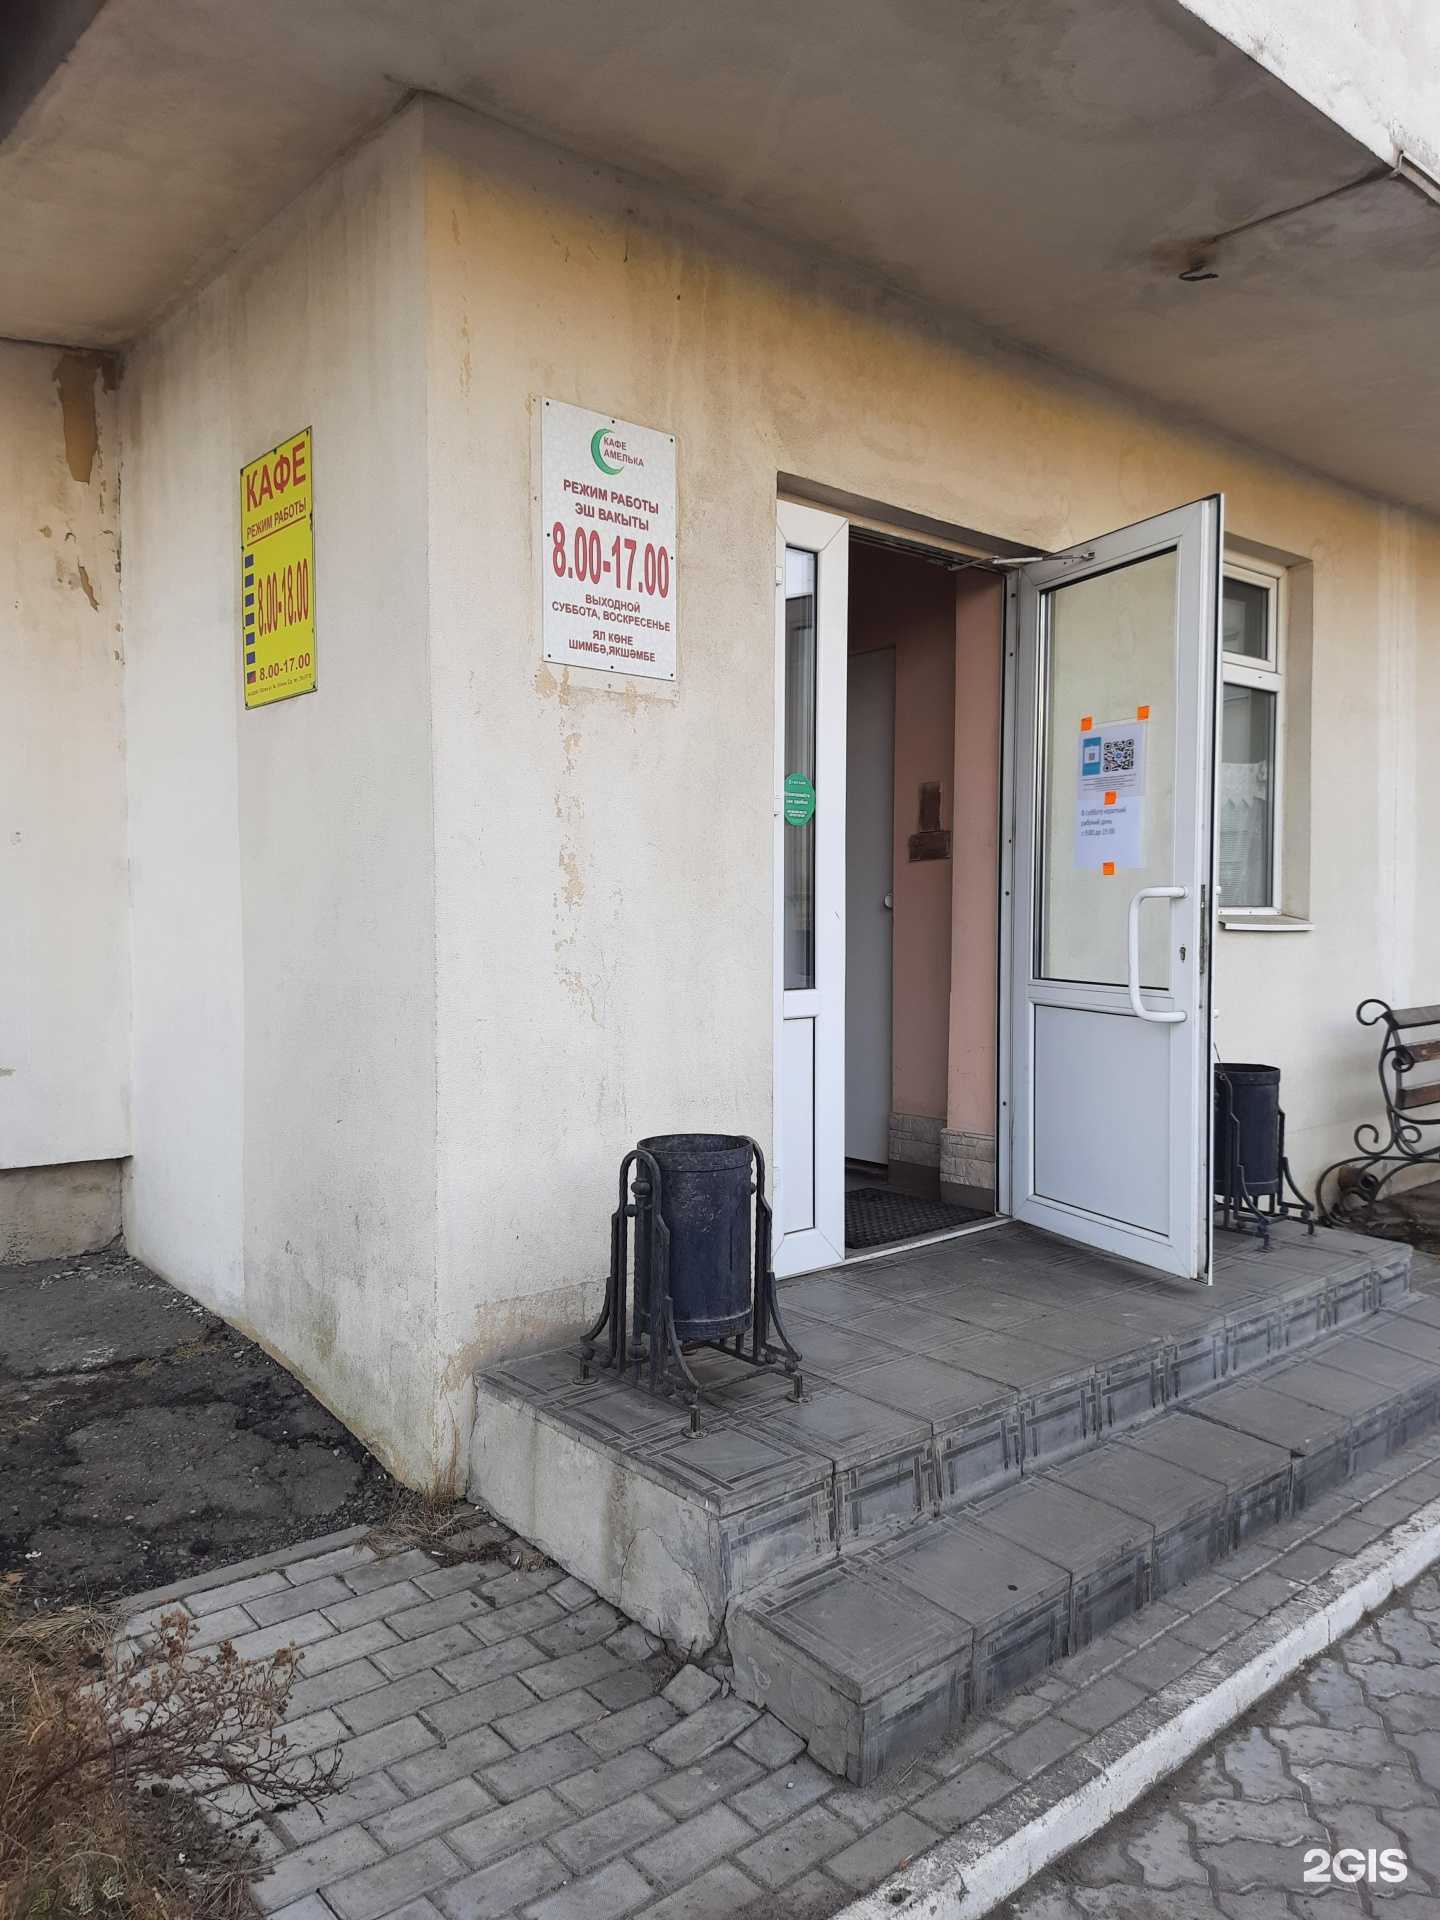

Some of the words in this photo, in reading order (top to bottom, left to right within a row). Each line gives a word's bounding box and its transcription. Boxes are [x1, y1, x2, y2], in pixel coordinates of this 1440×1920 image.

[604, 437, 627, 450] КАФЕ
[604, 449, 644, 467] АМЕЛЬКА
[246, 441, 306, 512] КАФЕ
[563, 479, 608, 501] РЕЖИМ
[610, 491, 659, 514] РАБОТЫ
[247, 515, 273, 540] РЕЖИМ
[274, 497, 306, 526] РАБОТЫ
[575, 502, 595, 518] ЭШ
[598, 508, 649, 531] ВАКЫТЫ
[552, 521, 669, 598] 8.00-17.00
[258, 558, 309, 636] 8.00-18.00
[585, 593, 641, 613] ВЫХОДНОЙ
[552, 601, 600, 620] СУББОТА,
[603, 610, 671, 632] ВОСКРЕСЕНЬЕ
[592, 630, 606, 641] ЯЛ
[608, 632, 634, 646] КӨНЕ
[259, 652, 311, 681] 8.00-17.00
